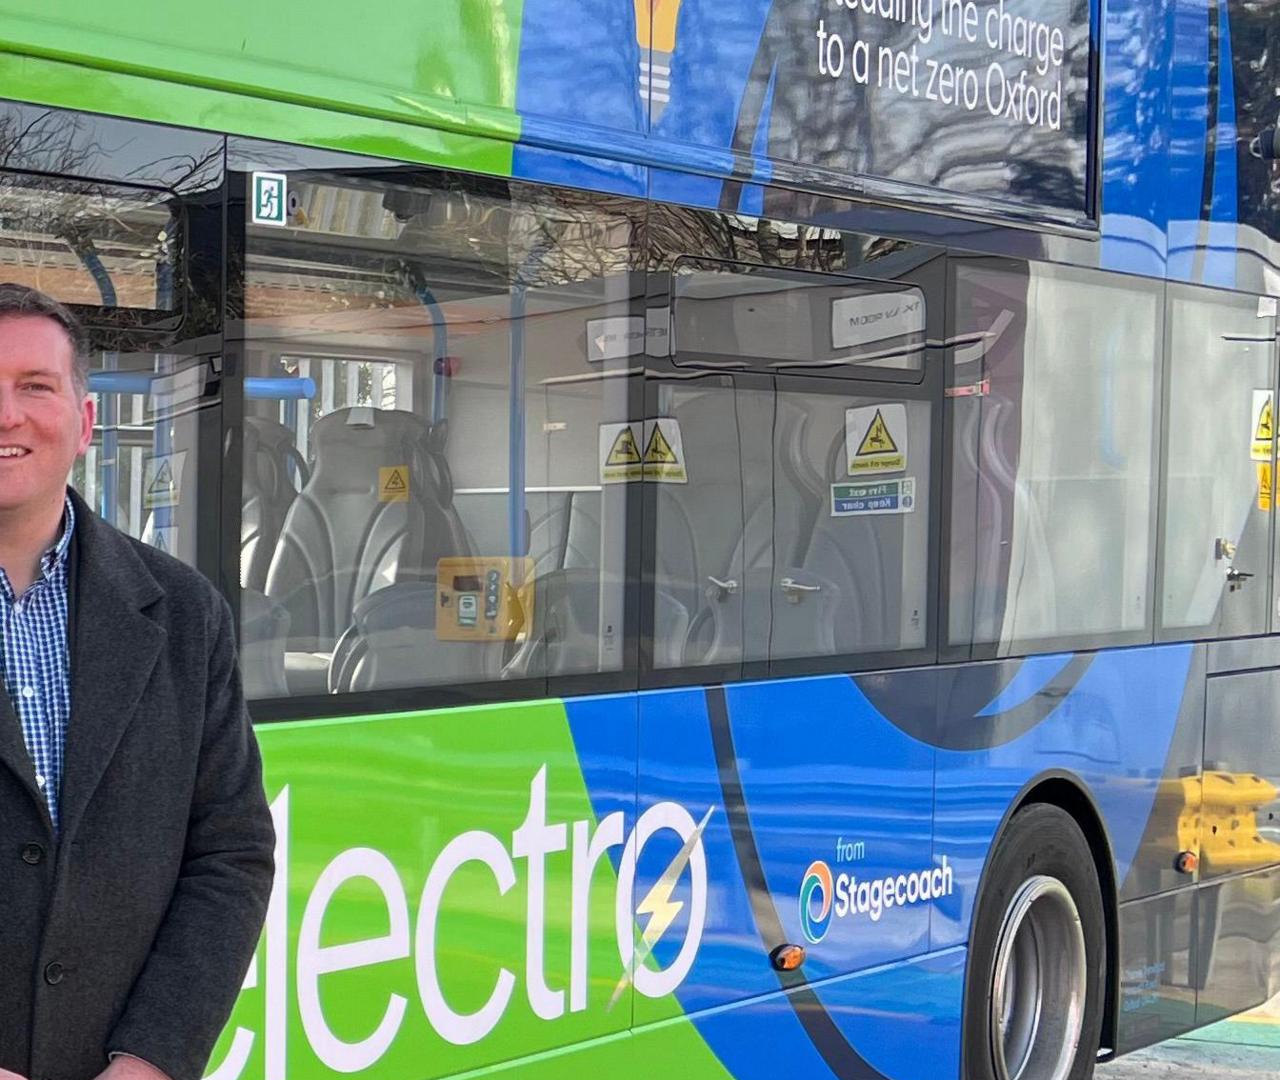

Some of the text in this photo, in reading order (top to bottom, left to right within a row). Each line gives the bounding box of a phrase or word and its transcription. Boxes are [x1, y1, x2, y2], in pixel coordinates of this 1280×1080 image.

[942, 0, 978, 42] the
[985, 0, 1064, 76] charge
[816, 20, 844, 78] to
[852, 40, 869, 85] a
[878, 45, 919, 97] net
[925, 58, 979, 110] zero
[985, 62, 1062, 131] Oxford
[836, 837, 865, 863] from
[834, 855, 953, 922] Stagecoach
